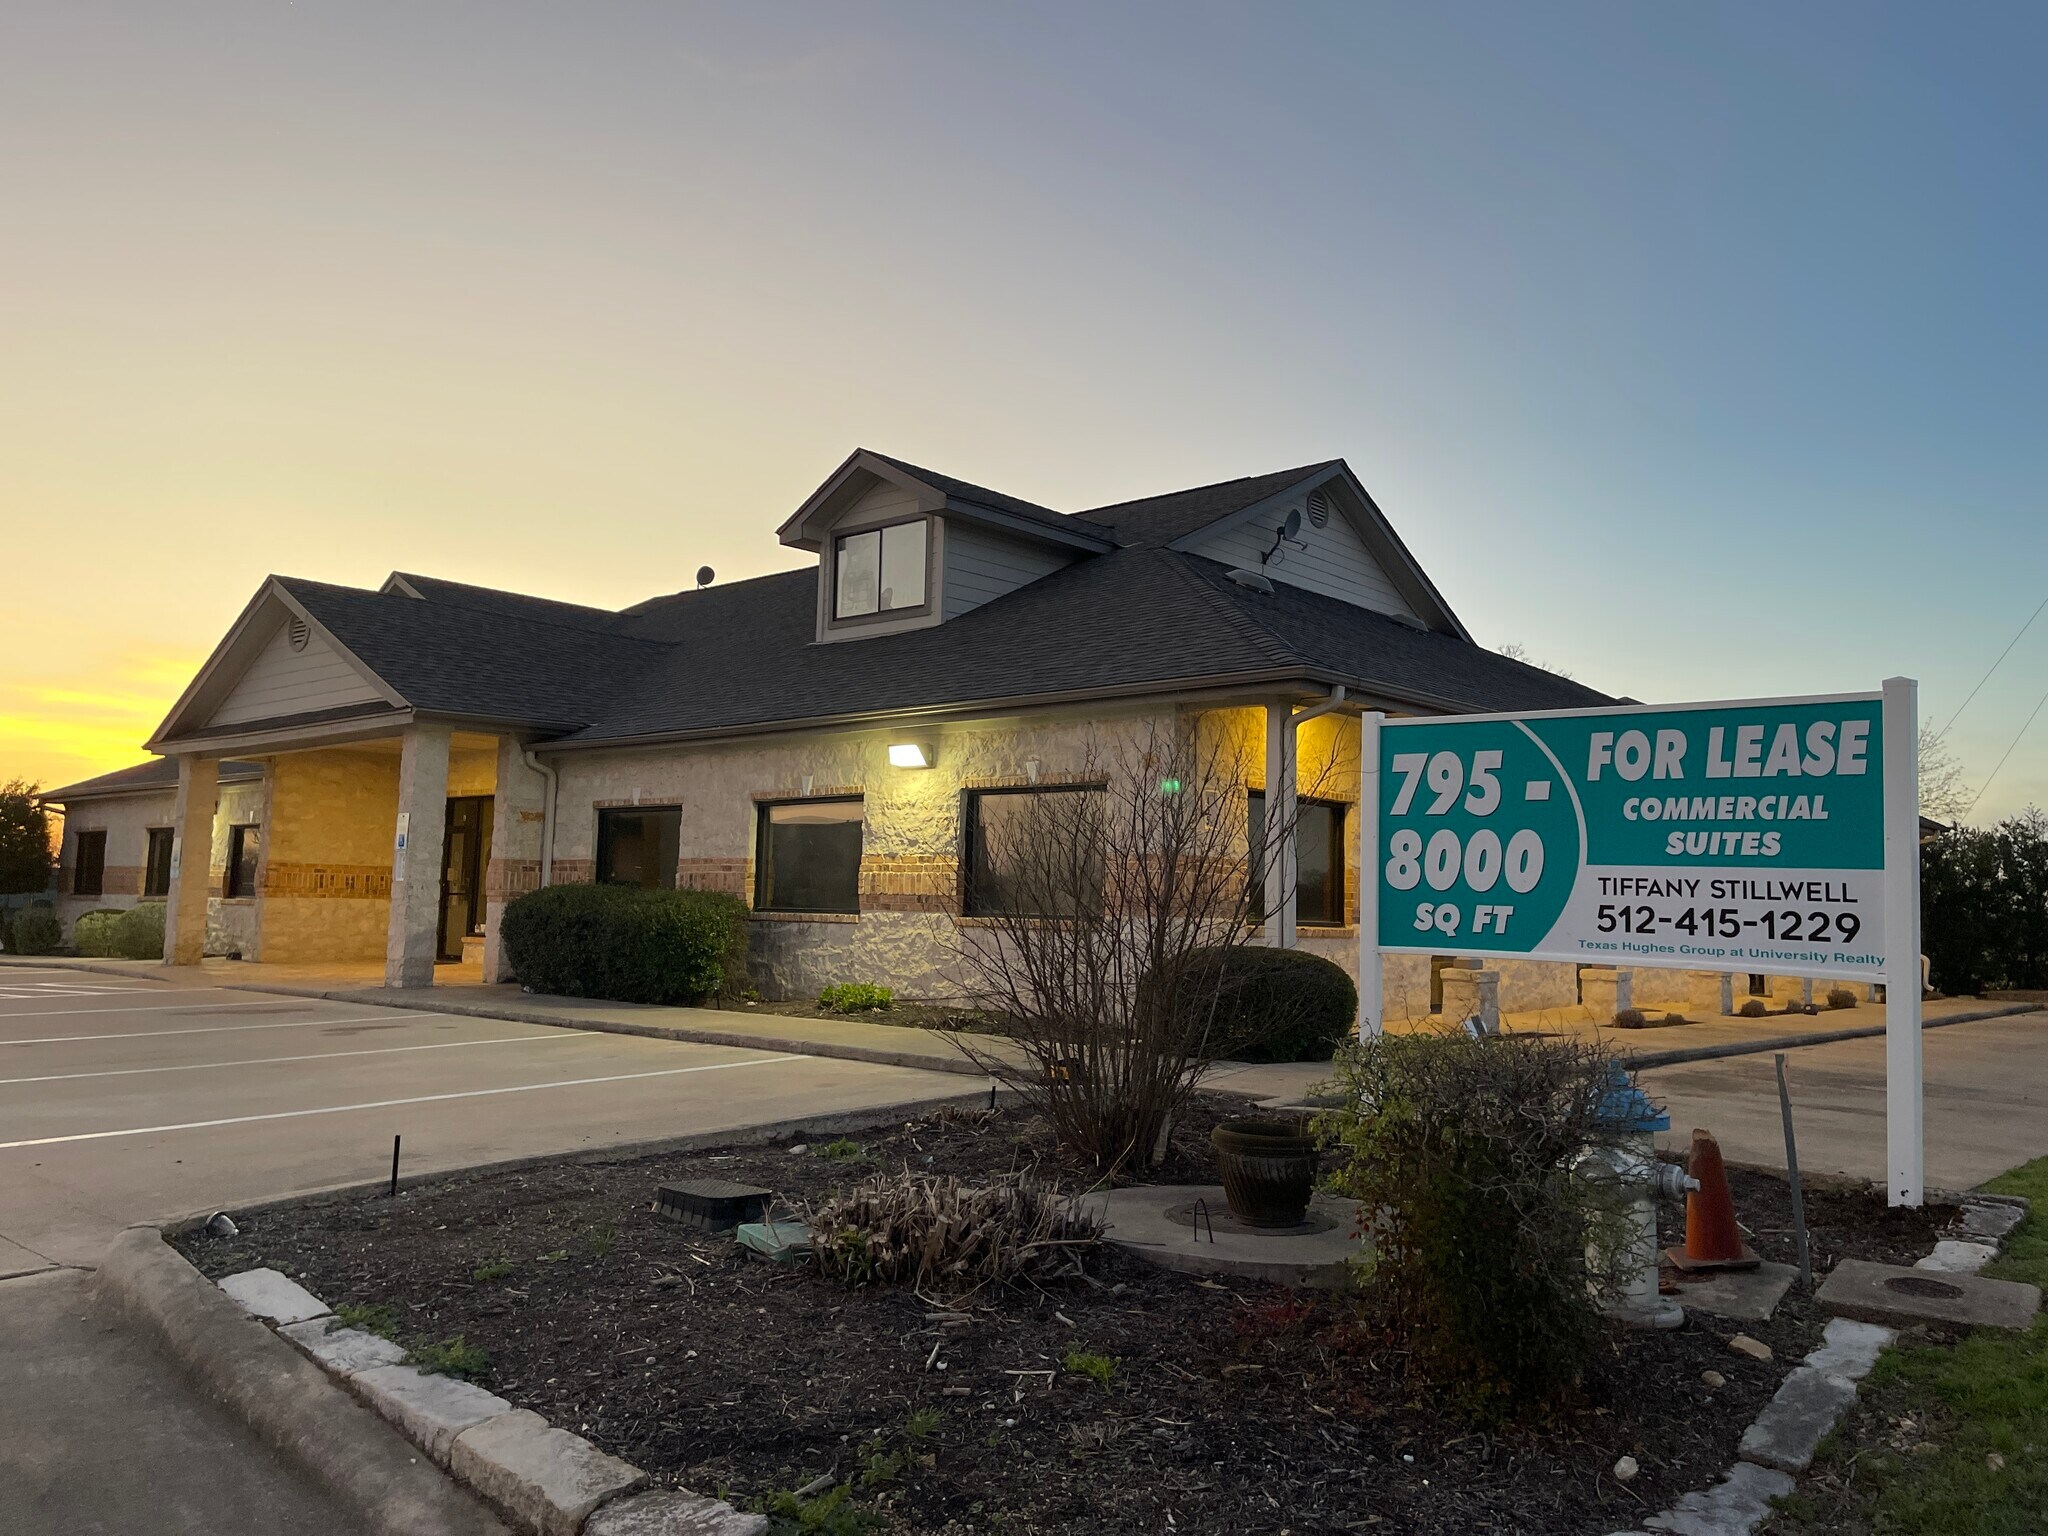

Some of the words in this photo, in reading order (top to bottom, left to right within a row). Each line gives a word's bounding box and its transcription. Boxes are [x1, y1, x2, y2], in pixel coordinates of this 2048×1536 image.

[1587, 728, 1687, 782] FOR
[1706, 720, 1870, 778] LEASE
[1389, 750, 1504, 816] 795
[1525, 781, 1551, 801] -
[1623, 795, 1829, 820] COMMERCIAL
[1385, 829, 1544, 893] 8000
[1665, 831, 1781, 857] SUITES
[1598, 877, 1700, 898] TIFFANY
[1711, 880, 1858, 903] STILLWELL
[1413, 902, 1460, 938] SQ
[1472, 904, 1513, 934] FT
[1597, 905, 1861, 943] 512-415-1229
[1578, 939, 1618, 950] Texas
[1622, 941, 1675, 954] Hughes
[1680, 945, 1726, 958] Group
[1730, 947, 1744, 957] at
[1749, 948, 1829, 963] University
[1834, 953, 1886, 966] Realty
